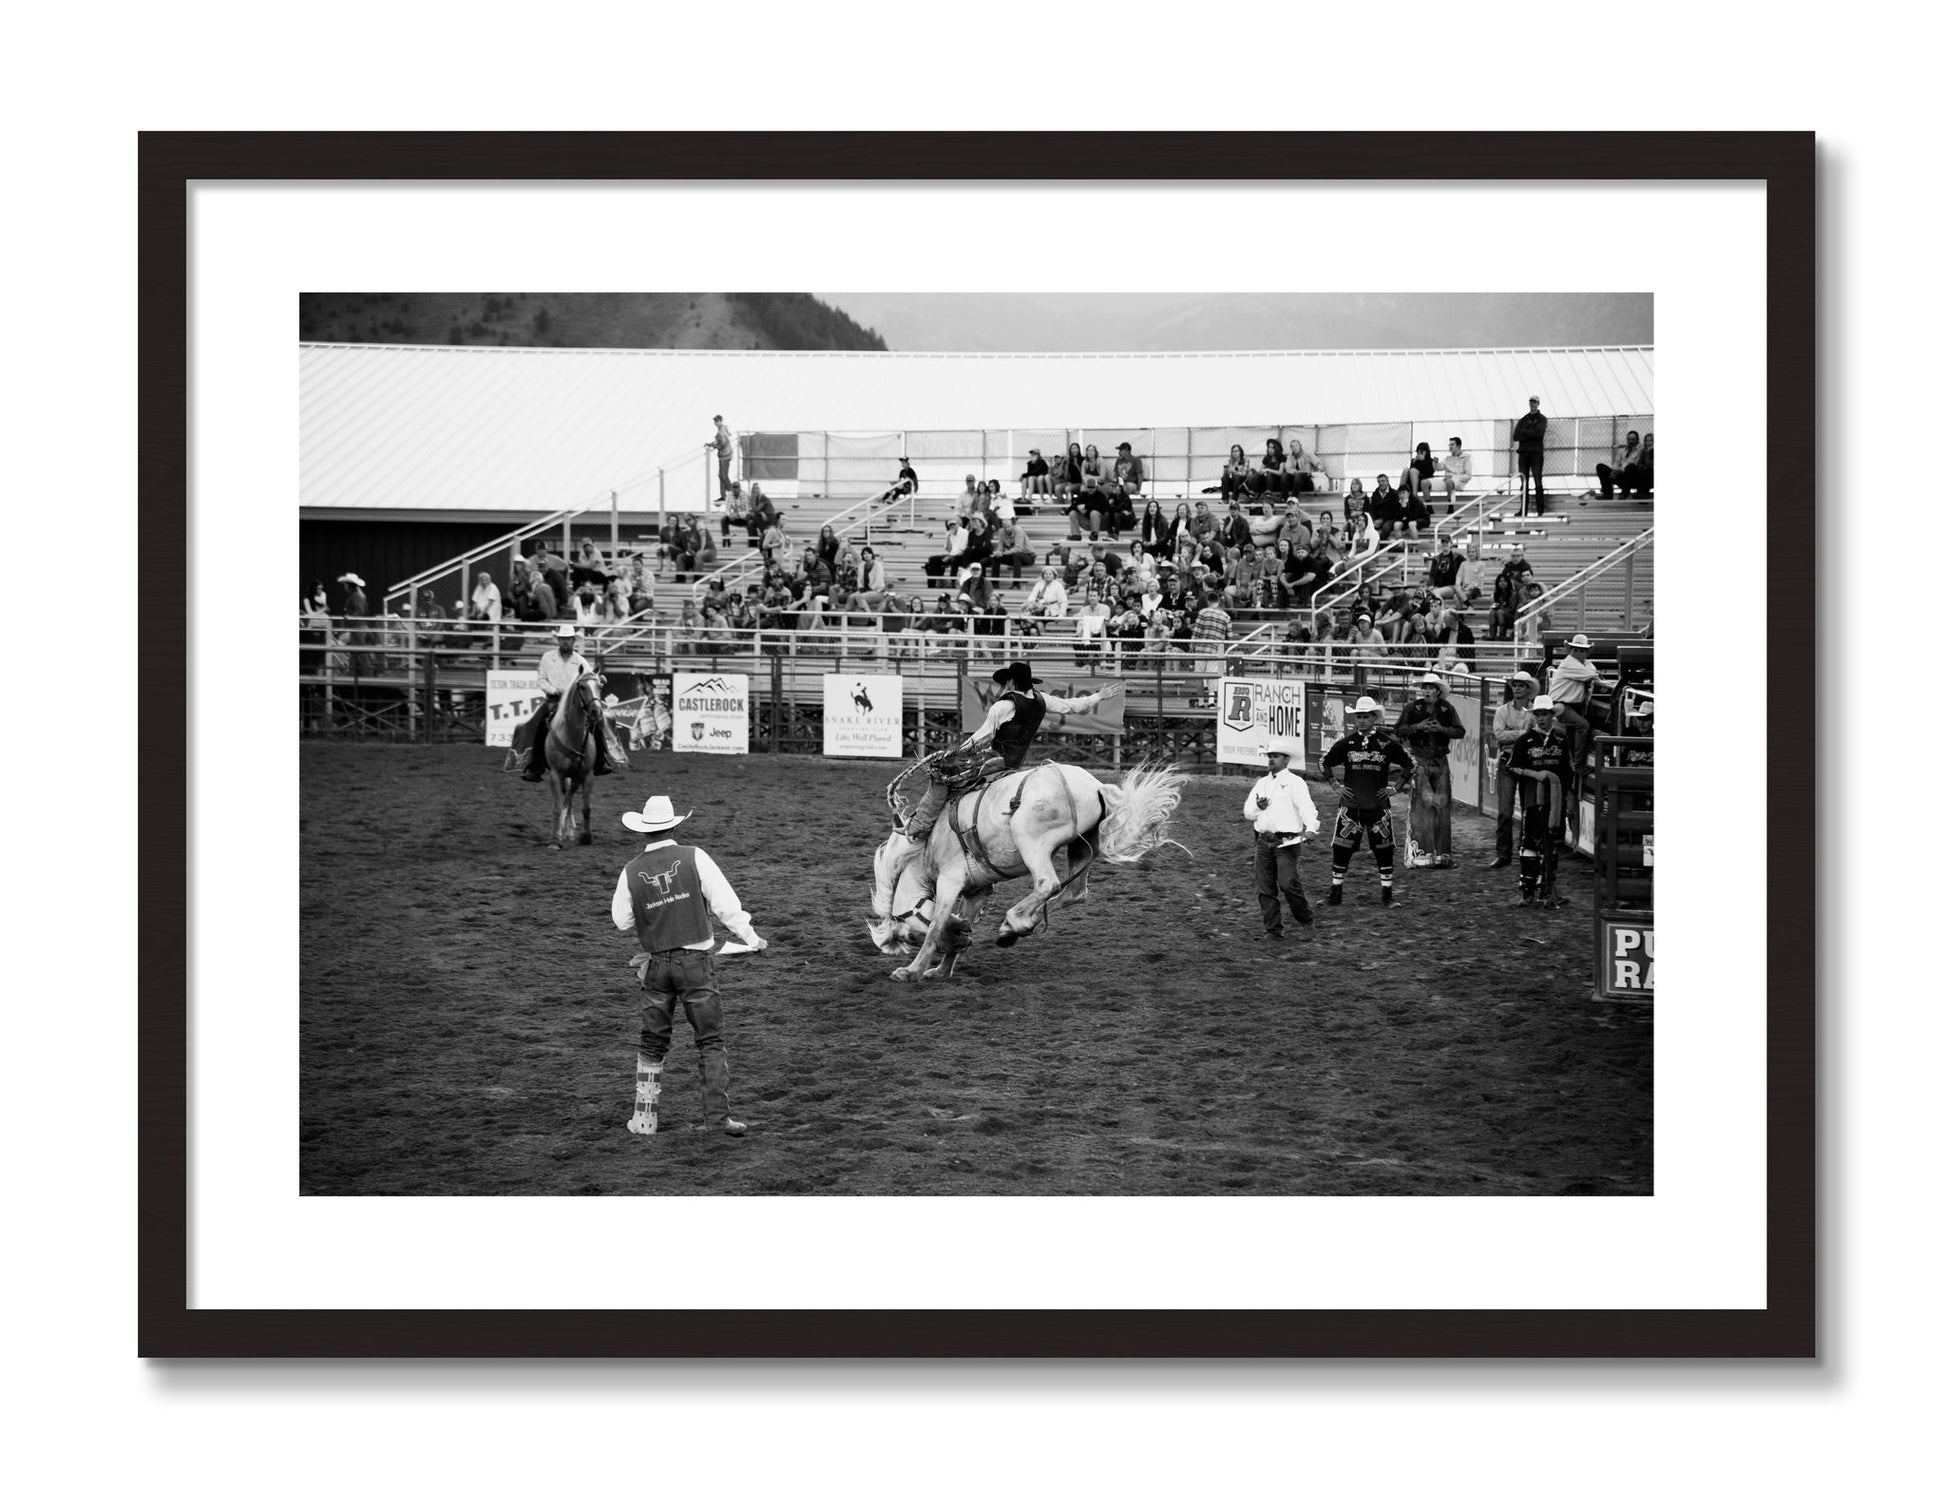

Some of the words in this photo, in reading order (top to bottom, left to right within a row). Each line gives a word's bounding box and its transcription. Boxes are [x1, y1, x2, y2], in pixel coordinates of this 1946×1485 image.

[1233, 686, 1250, 695] BIG
[1255, 683, 1301, 705] RANCH
[679, 698, 744, 712] CASTLEROCK
[1228, 695, 1251, 721] R
[825, 716, 860, 724] SNAKE
[867, 717, 901, 725] RIVER
[1269, 705, 1301, 737] HOME
[709, 727, 732, 739] Jeep
[646, 900, 663, 909] Jackson
[663, 896, 674, 904] Hole
[674, 892, 690, 900] Rodeo
